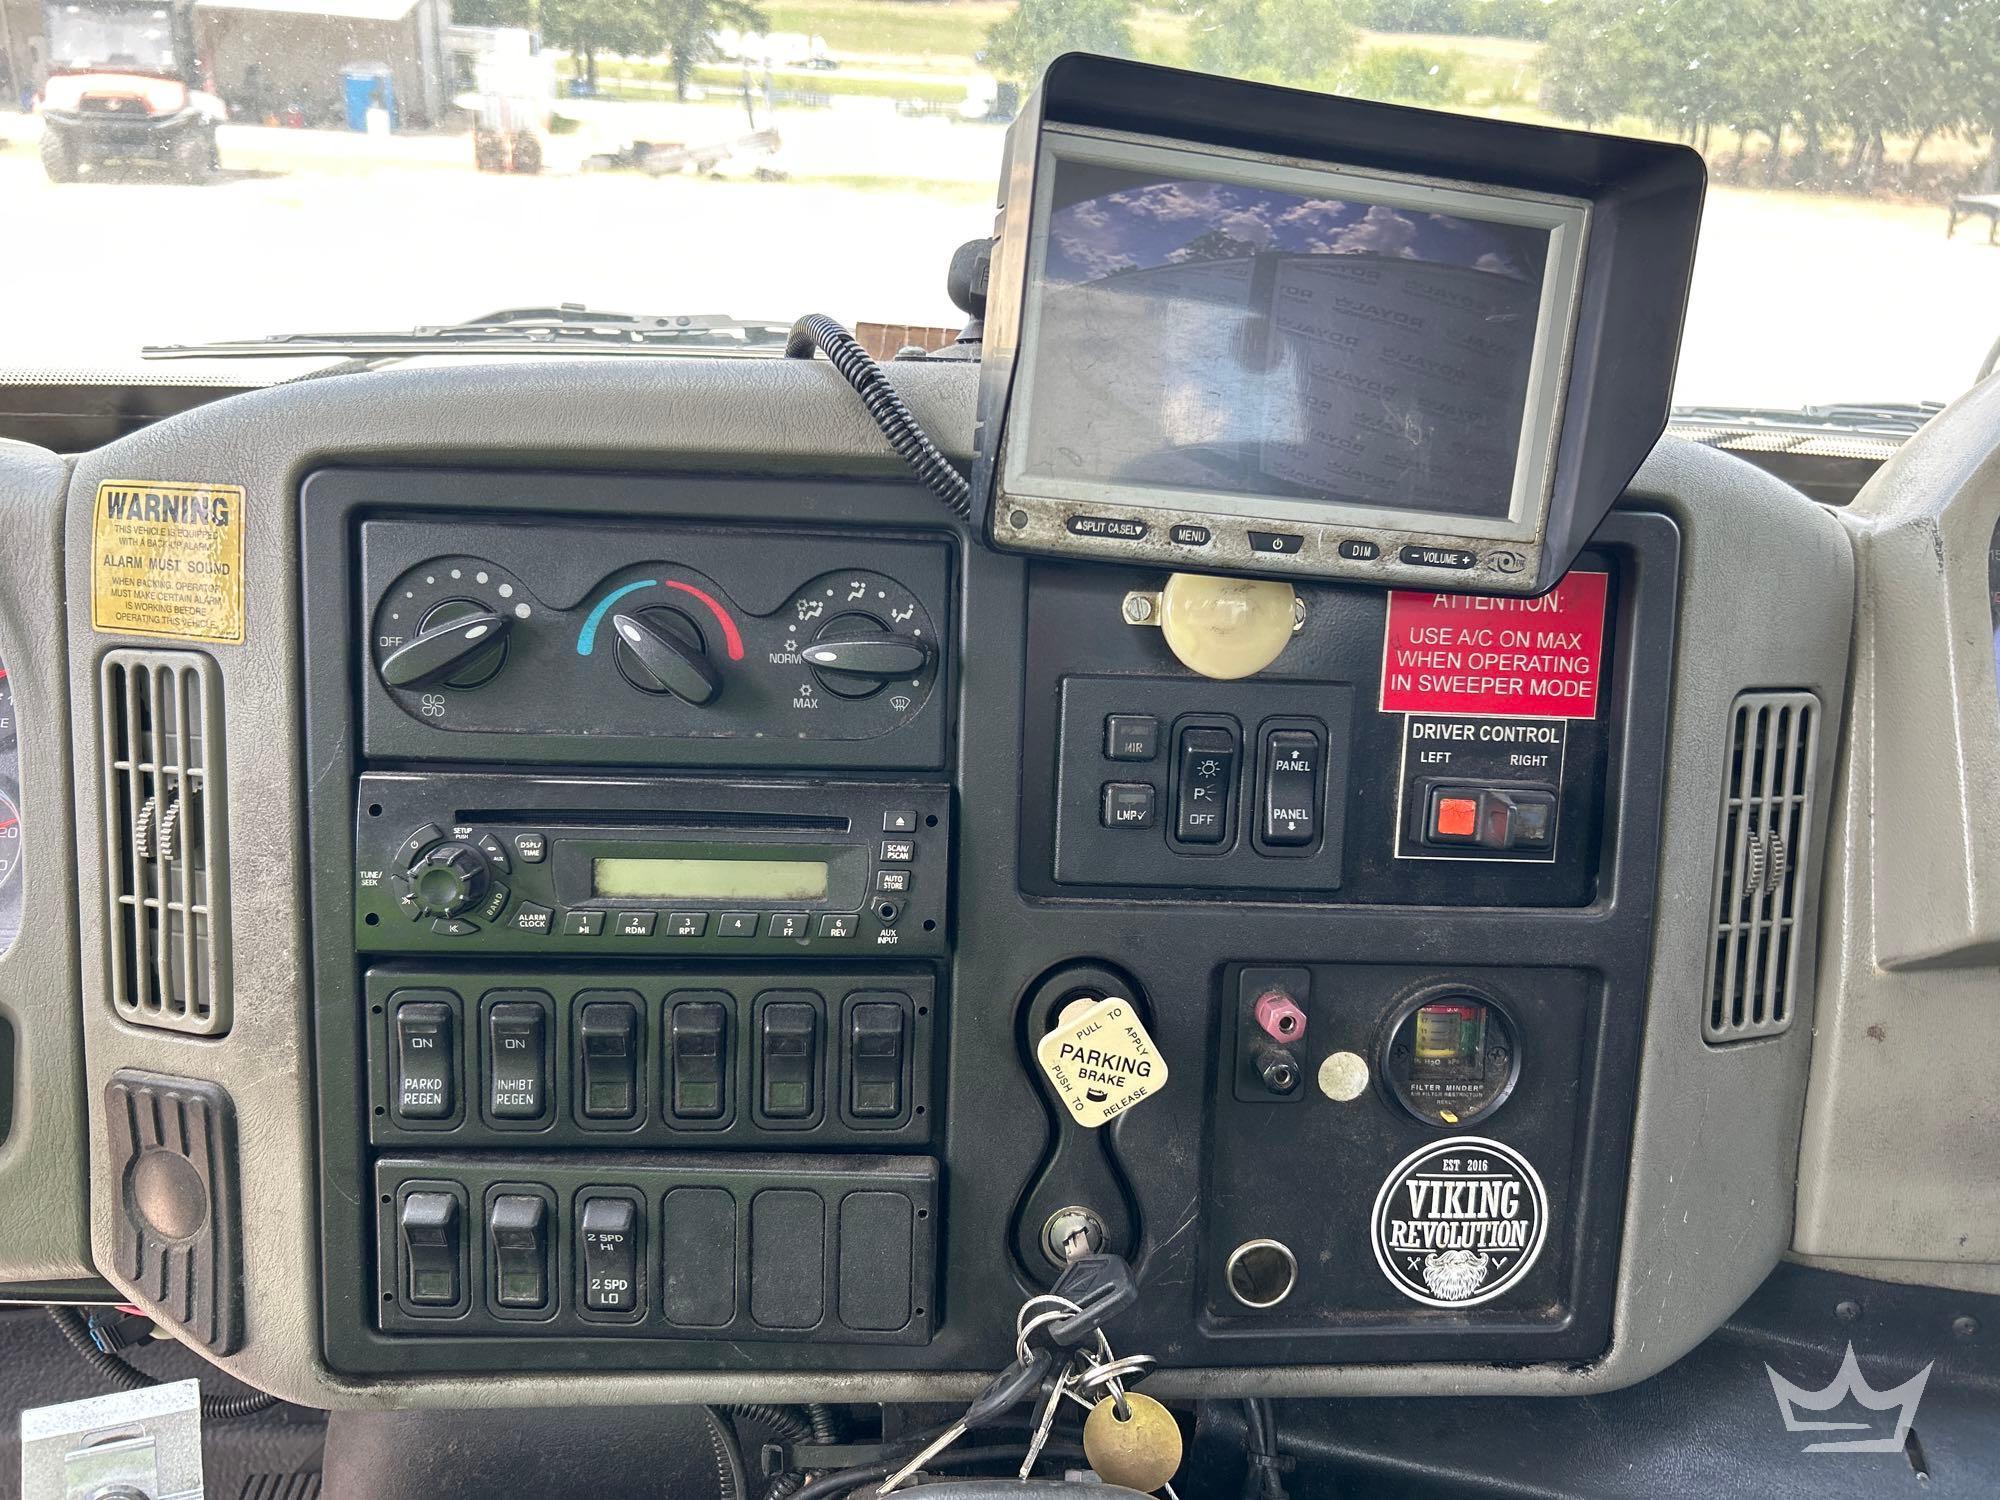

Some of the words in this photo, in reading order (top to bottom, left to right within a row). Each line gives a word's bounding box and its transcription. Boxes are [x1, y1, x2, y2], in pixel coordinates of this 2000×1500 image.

[107, 492, 229, 527] WARNING
[115, 525, 131, 533] THIS
[134, 526, 166, 536] VEHICLE
[167, 528, 176, 536] IS
[178, 528, 218, 540] EQUIPPED
[1082, 521, 1105, 533] SPLIT
[1178, 529, 1205, 542] MENU
[119, 538, 138, 546] WITH
[1352, 545, 1371, 557] DIM
[1423, 551, 1457, 565] VOLUME
[104, 555, 142, 568] ALARM
[149, 558, 181, 571] MUST
[188, 561, 230, 575] SOUND
[112, 577, 135, 586] WHEN
[176, 582, 221, 592] OPERATOR
[111, 589, 132, 597] MUST
[134, 591, 155, 600] MAKE
[158, 593, 193, 603] CERTAIN
[126, 602, 133, 610] IS
[135, 603, 172, 613] WORKING
[174, 606, 206, 616] BEFORE
[116, 612, 160, 624] OPERATING
[162, 616, 180, 625] THIS
[379, 637, 403, 647] OFF
[1410, 627, 1453, 645] USE
[1457, 630, 1493, 647] A/C
[1499, 631, 1530, 648] ON
[1537, 632, 1582, 650] MAX
[770, 653, 802, 664] NORM
[1397, 650, 1461, 669] WHEN
[1468, 653, 1590, 674] OPERATING
[1391, 674, 1411, 691] IN
[1418, 675, 1522, 695] SWEEPER
[1530, 680, 1592, 697] MODE
[793, 699, 818, 709] MAX
[1413, 723, 1475, 741] DRIVER
[1480, 726, 1560, 743] CONTROL
[1420, 752, 1451, 763] LEFT
[1510, 755, 1548, 766] RIGHT
[1276, 760, 1311, 771] PANEL
[1190, 814, 1215, 825] OFF
[1274, 809, 1309, 820] PANEL
[887, 844, 909, 852] SCAN/
[360, 871, 383, 879] TUNE/
[884, 875, 903, 883] AUTO
[884, 882, 903, 890] STORE
[487, 892, 503, 916] BAND
[735, 920, 742, 928] 4
[831, 929, 847, 937] REV
[880, 929, 896, 937] AUX
[1076, 1022, 1102, 1040] PULL
[1107, 1008, 1122, 1021] TO
[1125, 1026, 1149, 1056] APPLY
[412, 1038, 432, 1048] ON
[505, 1039, 526, 1048] ON
[1060, 1043, 1151, 1077] PARKING
[1078, 1068, 1125, 1087] BRAKE
[405, 1079, 442, 1090] PARKD
[498, 1079, 534, 1091] INHIBT
[1052, 1065, 1072, 1092] PUSH
[1072, 1097, 1084, 1111] TO
[1103, 1087, 1148, 1117] RELEASE
[404, 1093, 441, 1105] REGEN
[497, 1094, 534, 1105] REGEN
[1443, 1159, 1460, 1171] EST
[1467, 1159, 1488, 1171] 2016
[1406, 1179, 1520, 1219] VIKING
[600, 1234, 623, 1242] SPD
[1389, 1220, 1528, 1248] REVOLUTION
[600, 1243, 614, 1251] HI
[592, 1279, 600, 1289] 2
[604, 1279, 627, 1290] SPD
[601, 1293, 618, 1303] LO
